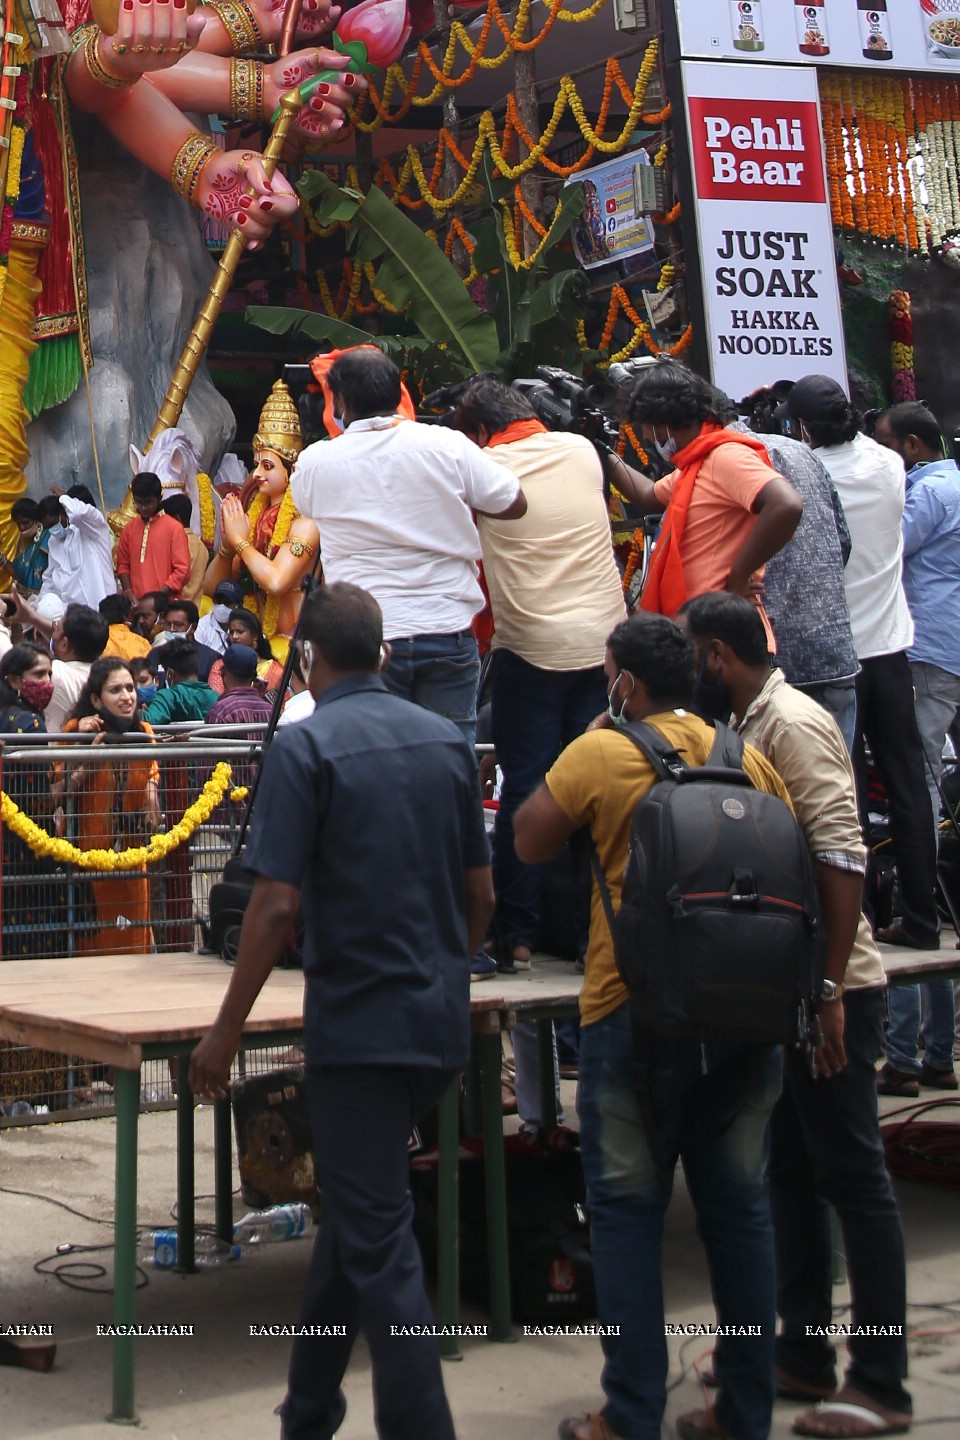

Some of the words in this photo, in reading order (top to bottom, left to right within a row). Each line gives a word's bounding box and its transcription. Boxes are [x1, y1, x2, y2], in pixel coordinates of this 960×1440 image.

[704, 116, 805, 151] Pehli
[710, 152, 805, 186] Baar
[716, 230, 808, 261] JUST
[715, 267, 818, 298] SOAK
[730, 309, 819, 330] HAKKA
[717, 335, 833, 356] NOODLES
